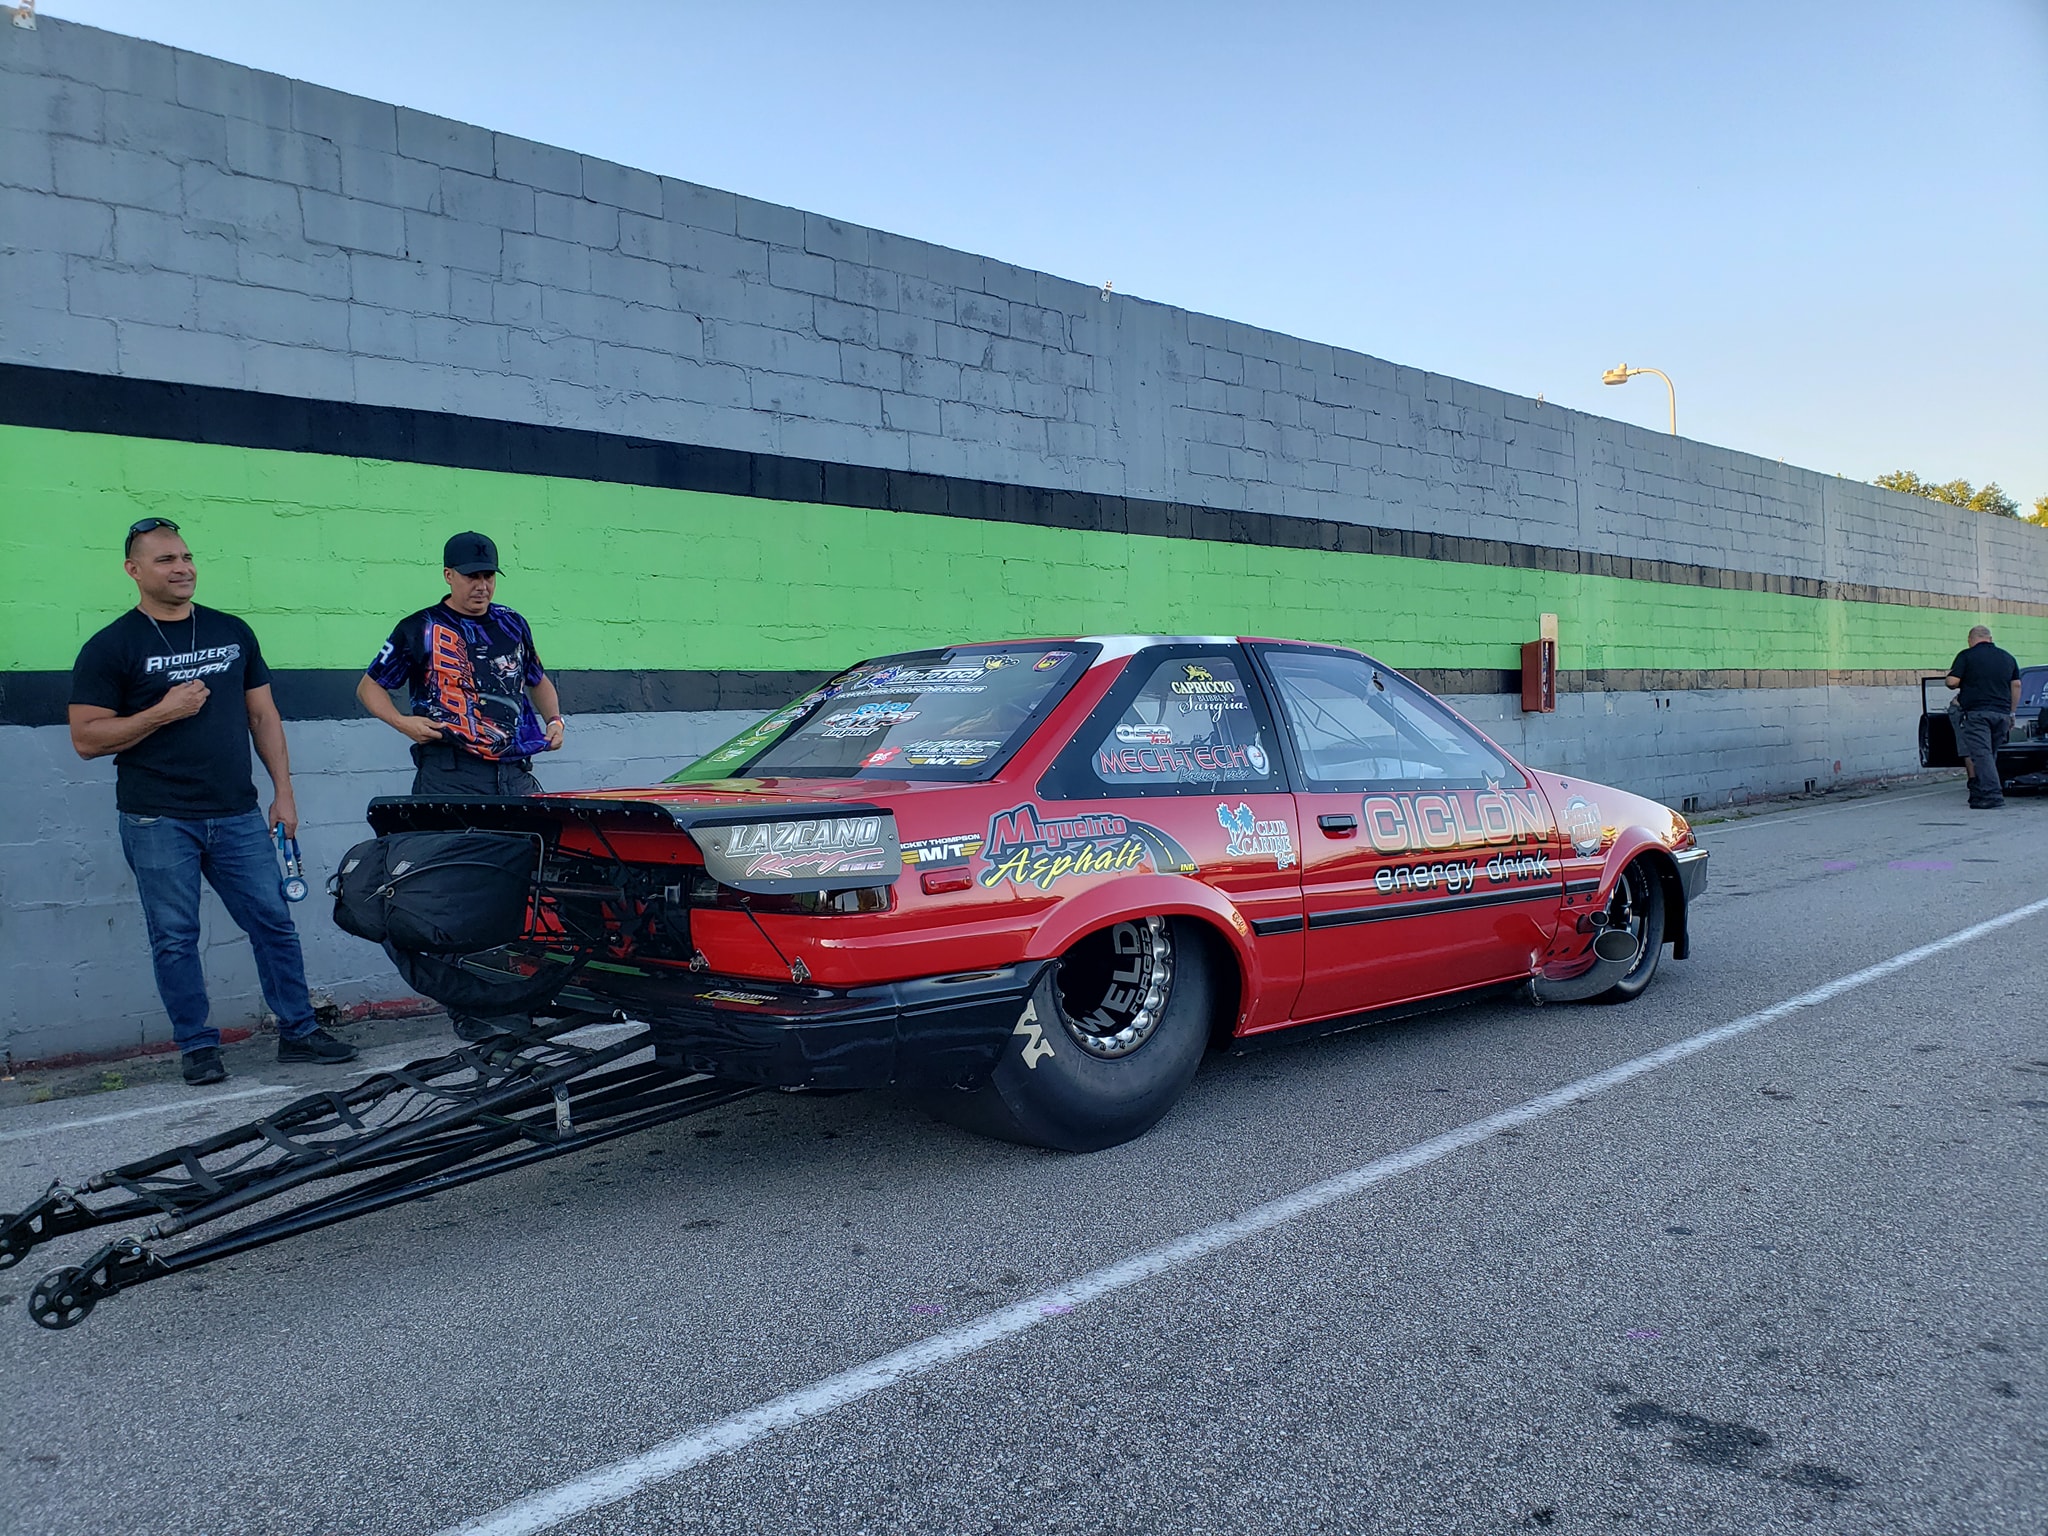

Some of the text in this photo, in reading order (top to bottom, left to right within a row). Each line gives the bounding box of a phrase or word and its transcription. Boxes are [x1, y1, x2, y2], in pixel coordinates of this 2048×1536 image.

[167, 662, 232, 682] 700 PPH
[1171, 681, 1236, 695] CAPRICCIO
[1098, 744, 1250, 774] MECH-TECH
[725, 816, 882, 858] LAZCANO
[899, 833, 981, 850] ICKEY THOMPSON
[993, 804, 1128, 855] Miguelito
[1256, 820, 1289, 836] CLUB
[918, 843, 965, 862] M/T
[1241, 835, 1292, 856] CARIBE
[985, 839, 1143, 889] Asphalt
[1374, 849, 1551, 892] energy drink
[1073, 921, 1142, 1034] WELD
[1129, 926, 1153, 1015] FORGED
